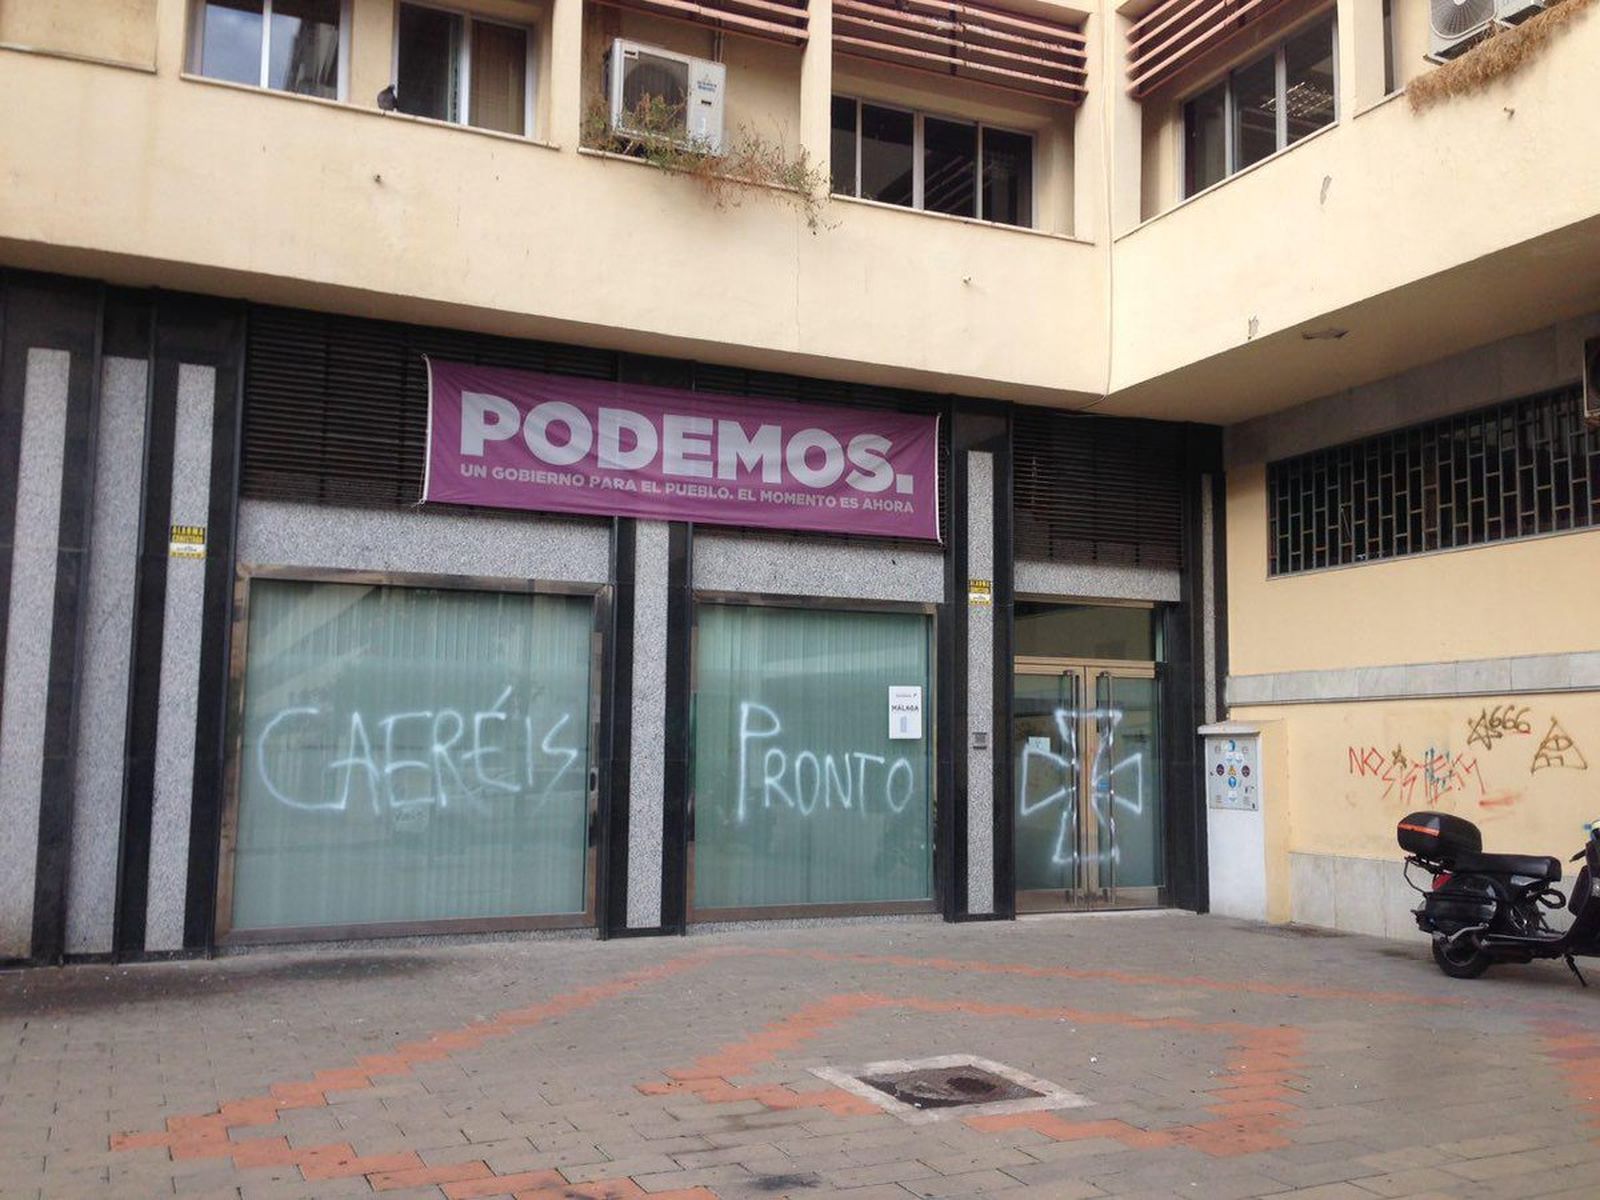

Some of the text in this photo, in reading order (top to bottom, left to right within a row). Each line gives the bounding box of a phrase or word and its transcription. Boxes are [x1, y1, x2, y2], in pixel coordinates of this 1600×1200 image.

[460, 390, 914, 495] PODEMOS.
[461, 463, 914, 513] UN GOBIERNO PARA EL PUEBLO. EL MOMENTO ES AHORA
[258, 685, 578, 816] CAERÉIS
[1488, 705, 1532, 733] 666
[738, 701, 914, 823] PRONTO
[1348, 746, 1384, 776] NO
